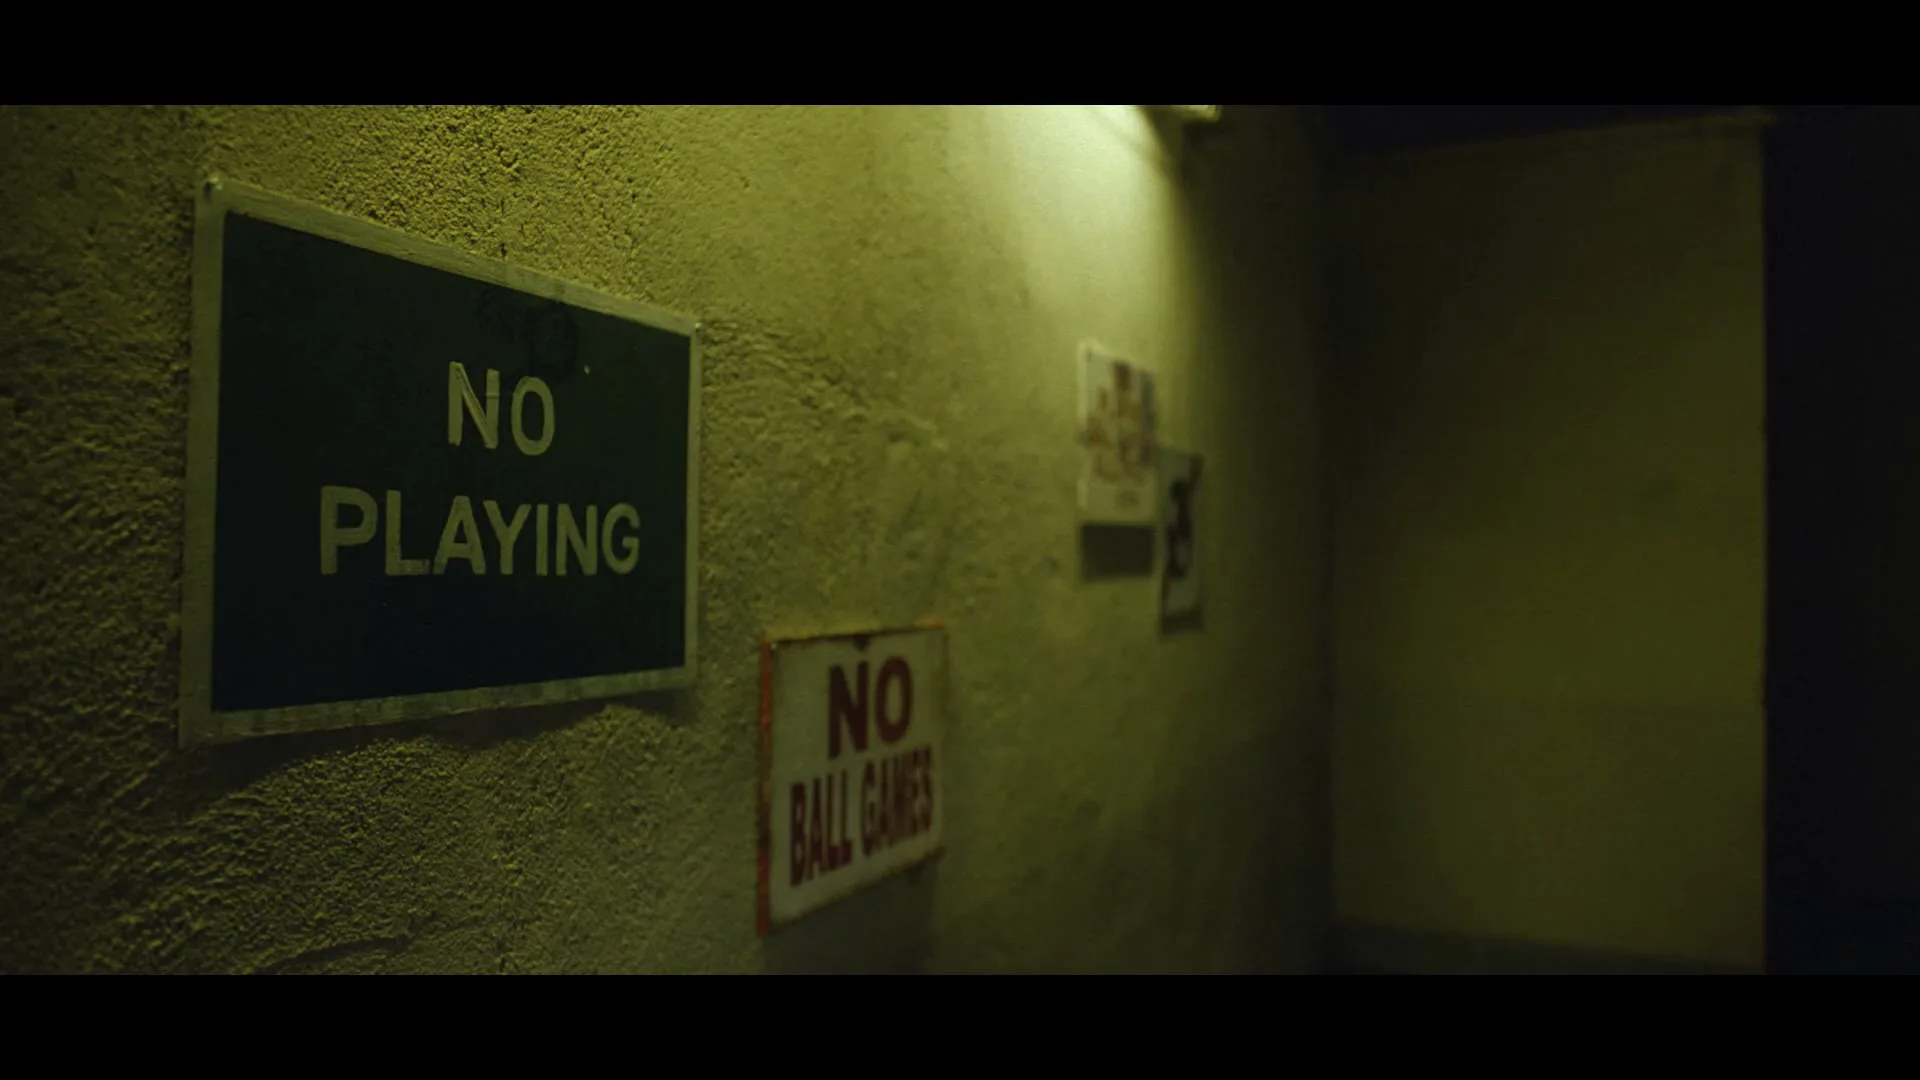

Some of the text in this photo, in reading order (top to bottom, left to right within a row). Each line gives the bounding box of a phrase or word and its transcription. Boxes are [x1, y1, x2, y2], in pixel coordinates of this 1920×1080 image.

[448, 360, 556, 457] NO
[319, 484, 642, 577] PLAYING
[828, 656, 912, 760] NO
[790, 745, 934, 888] BALL GAMES
